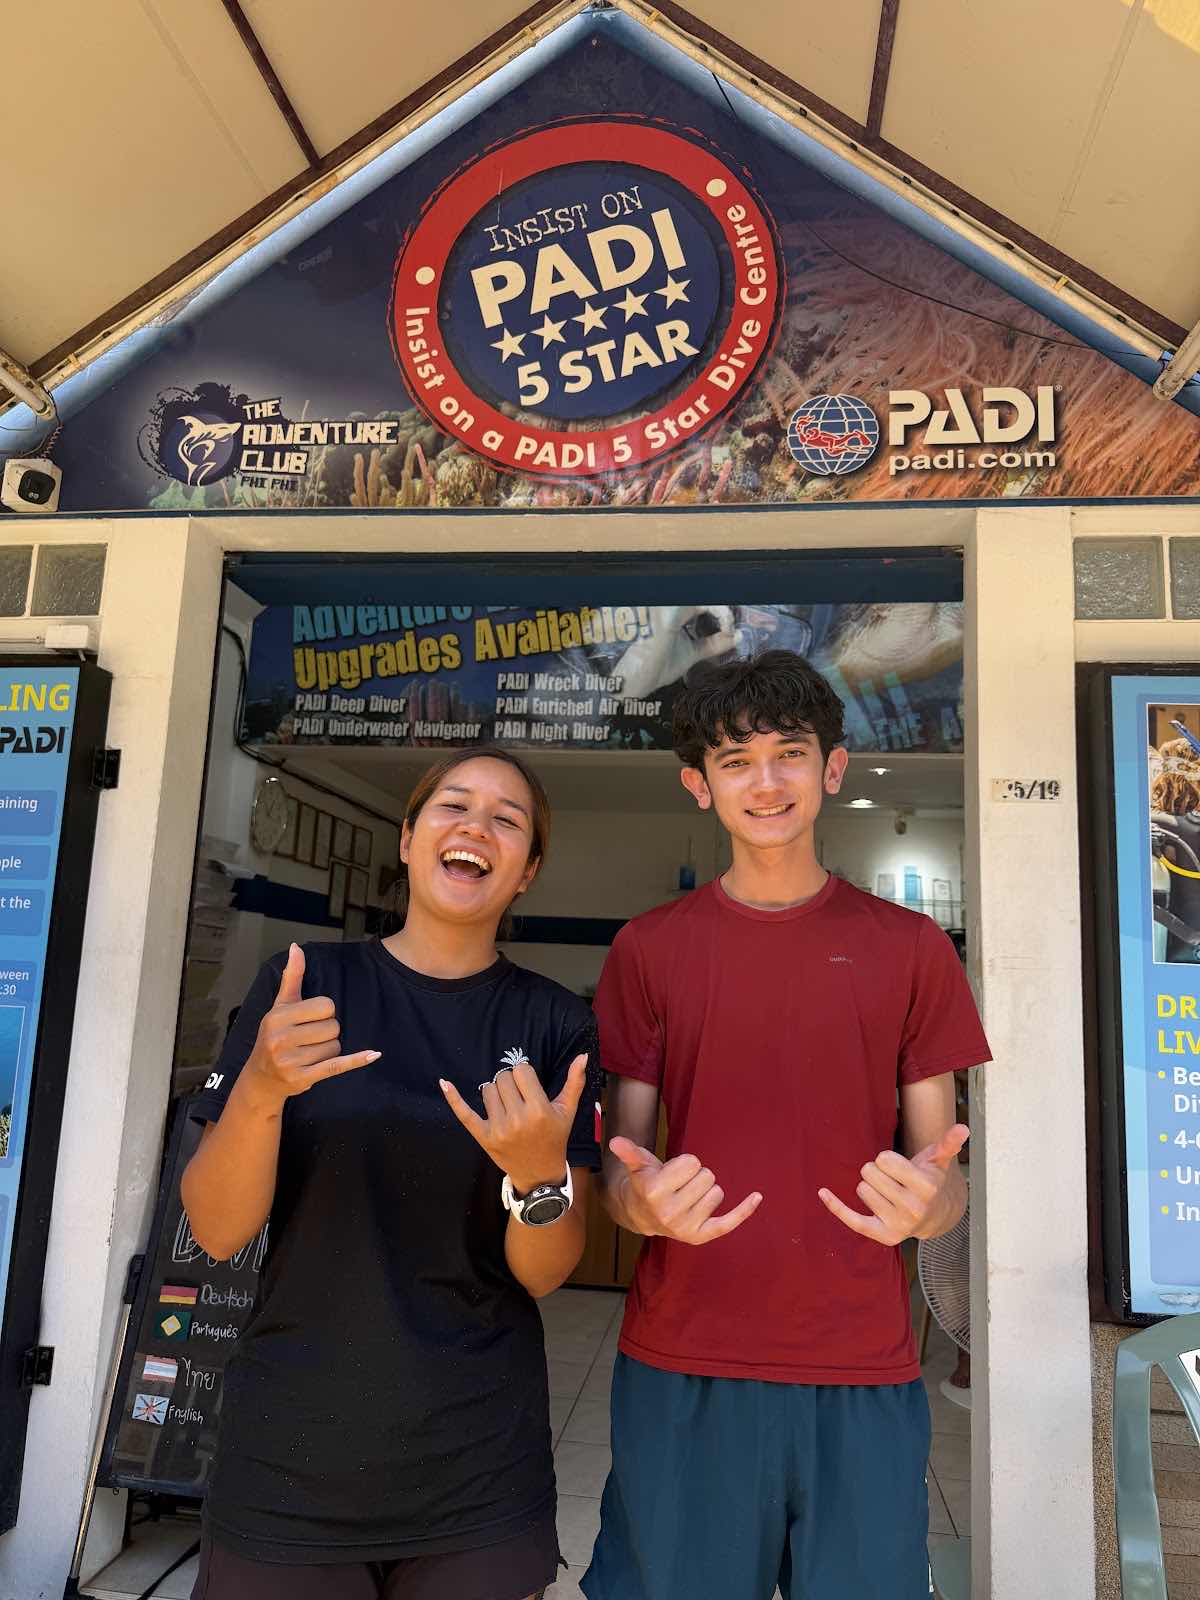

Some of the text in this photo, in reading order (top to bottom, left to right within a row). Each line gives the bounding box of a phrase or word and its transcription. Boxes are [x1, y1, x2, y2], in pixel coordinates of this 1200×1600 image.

[483, 186, 644, 252] INSIST ON
[470, 208, 687, 329] PADI
[405, 204, 767, 468] Insist on a PADI 5 Star Dive Centre
[518, 319, 700, 406] 5 STAR
[242, 400, 280, 420] THE
[889, 385, 1055, 446] PADI
[242, 421, 398, 446] ADVENTURE
[240, 450, 307, 474] CLUB
[889, 449, 1056, 475] padi.com
[241, 476, 298, 491] PHI PHI
[293, 606, 652, 691] Upgrades Available!
[497, 672, 623, 692] PADI Wreck Diver
[0, 684, 71, 712] ING
[295, 693, 408, 714] PADI Deep Diver
[496, 697, 662, 717] PADI Enriched Air Diver
[0, 726, 65, 753] PADI
[293, 718, 481, 740] PADI Underwater Navigator
[494, 720, 610, 742] PADI Night Diver
[0, 855, 21, 873] ple
[9, 896, 31, 909] the
[1174, 1093, 1200, 1113] Di
[201, 1284, 253, 1310] Deutsch
[191, 1321, 238, 1342] Português
[181, 1356, 215, 1390] ไทย
